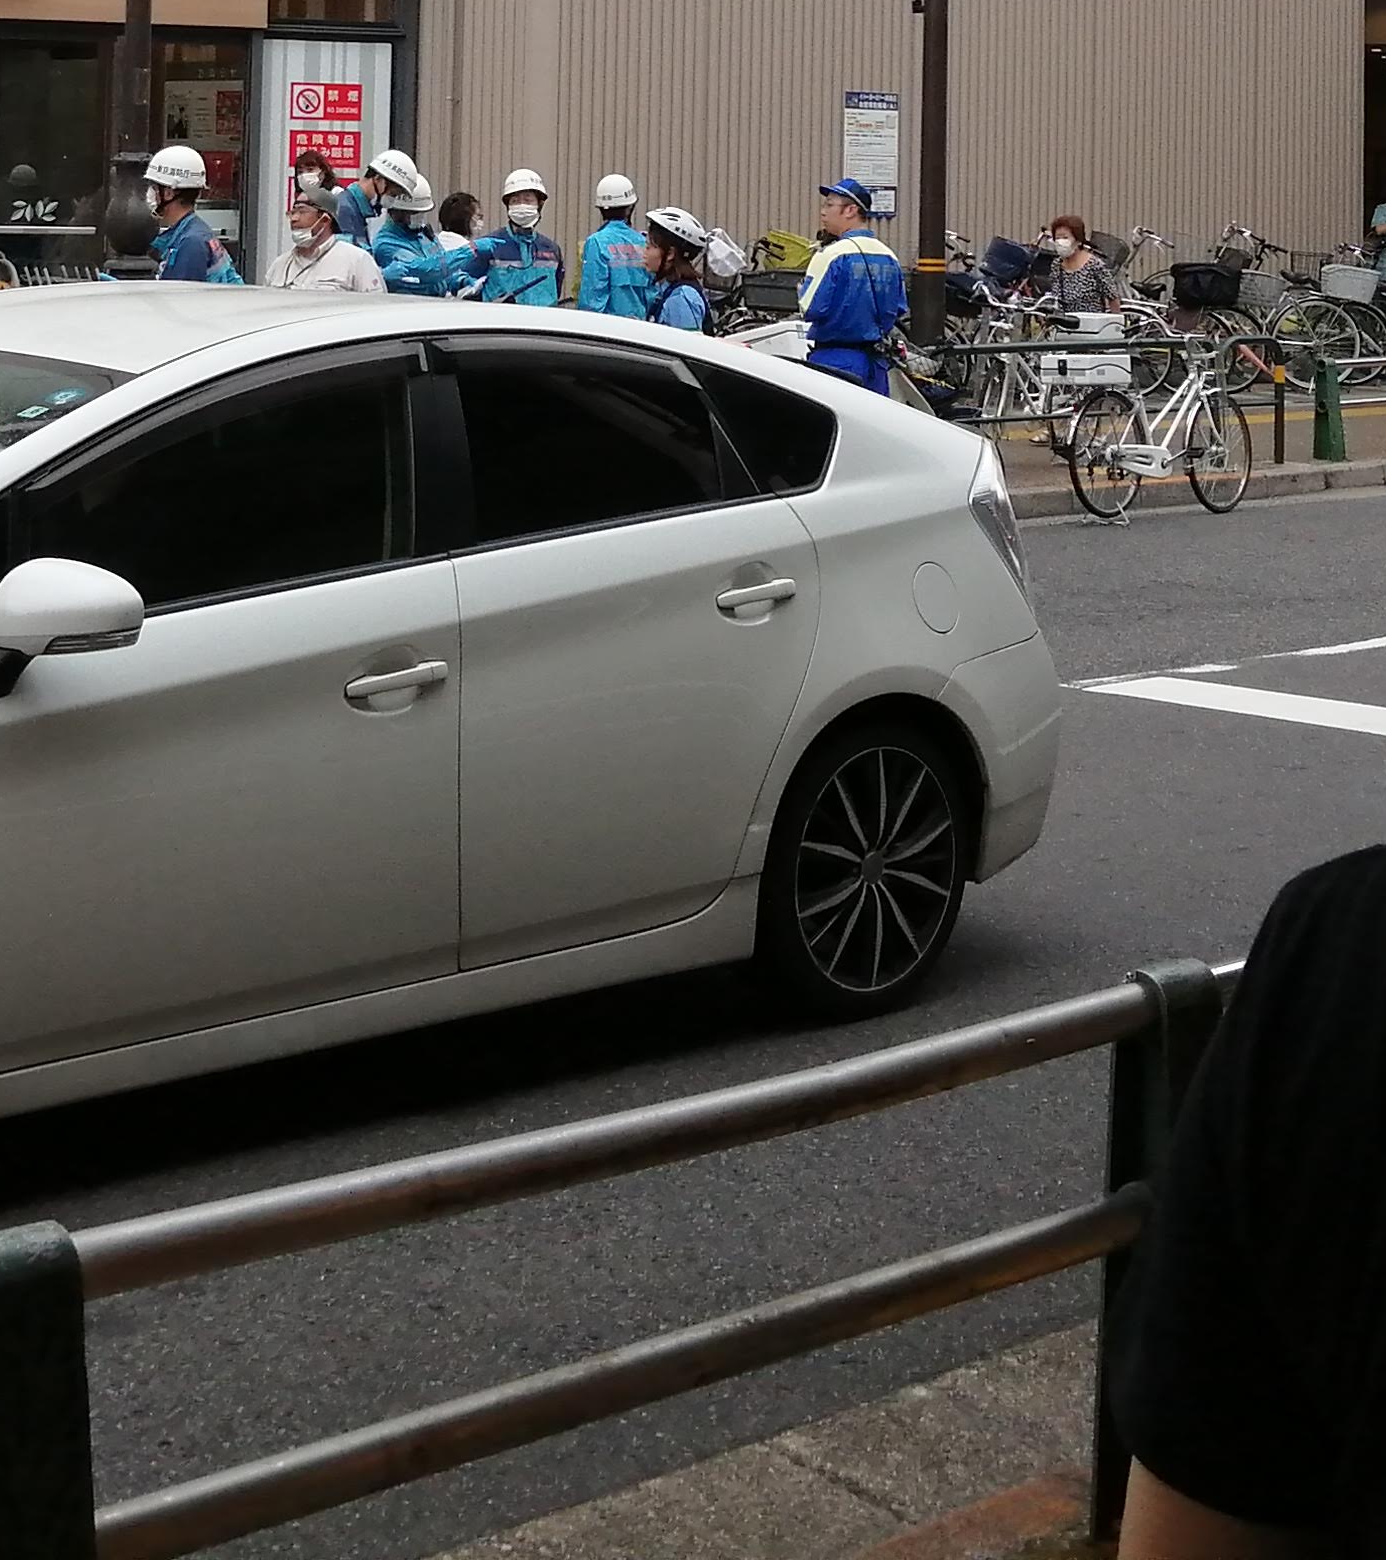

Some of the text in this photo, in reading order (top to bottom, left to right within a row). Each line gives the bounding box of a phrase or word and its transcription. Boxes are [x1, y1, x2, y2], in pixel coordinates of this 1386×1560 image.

[327, 90, 359, 102] 禁煙
[296, 133, 354, 145] 危険物品
